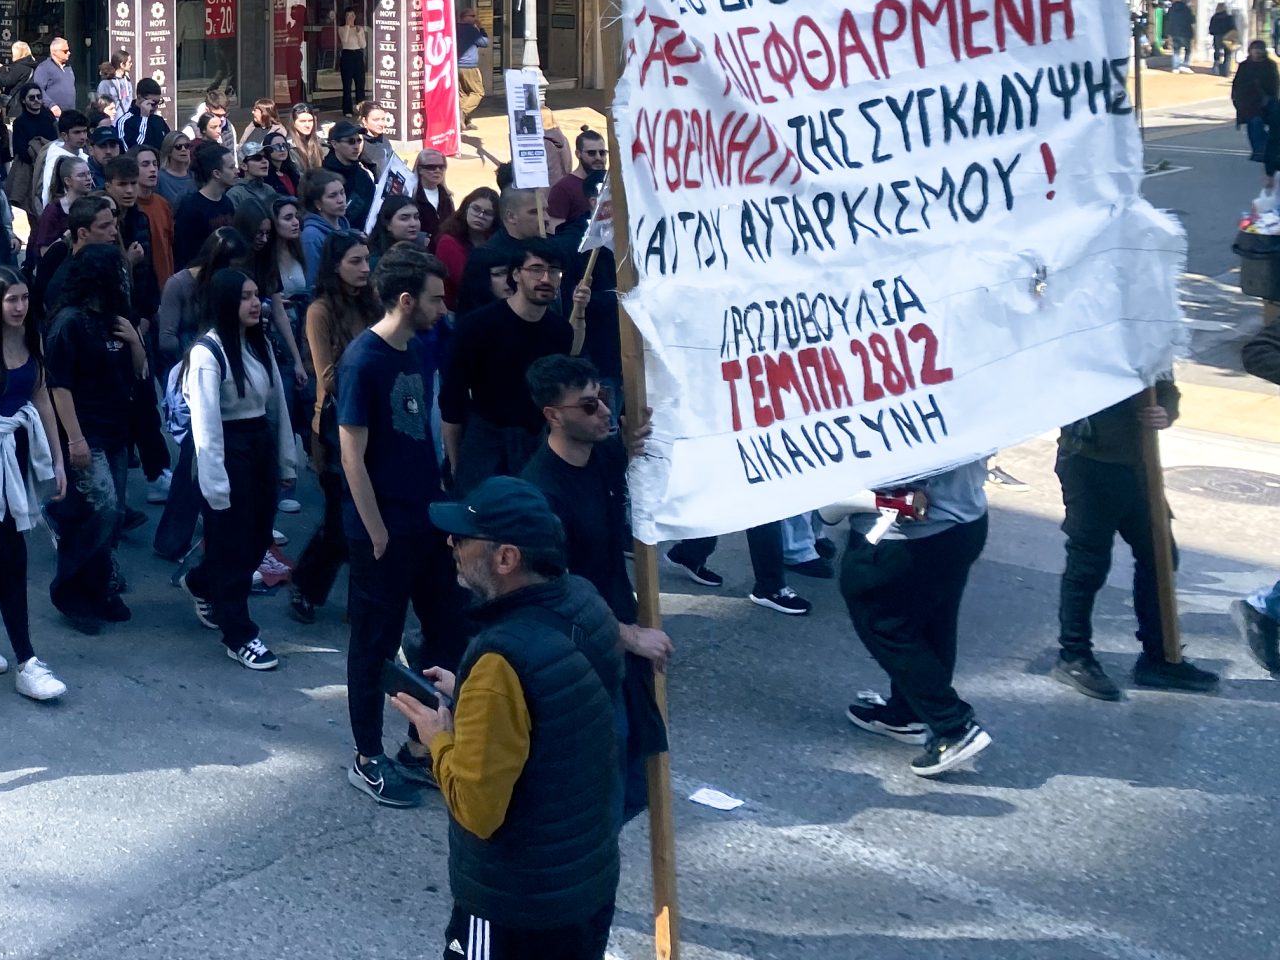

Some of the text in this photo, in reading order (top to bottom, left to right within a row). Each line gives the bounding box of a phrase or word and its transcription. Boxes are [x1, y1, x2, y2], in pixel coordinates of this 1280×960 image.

[858, 58, 1135, 164] ΣΥΓΚΑΛΥΨΗΣ
[720, 345, 854, 432] ΤΕΜΠΗ
[736, 393, 949, 485] ΔΙΚΑΙΟΣΥΝΗ
